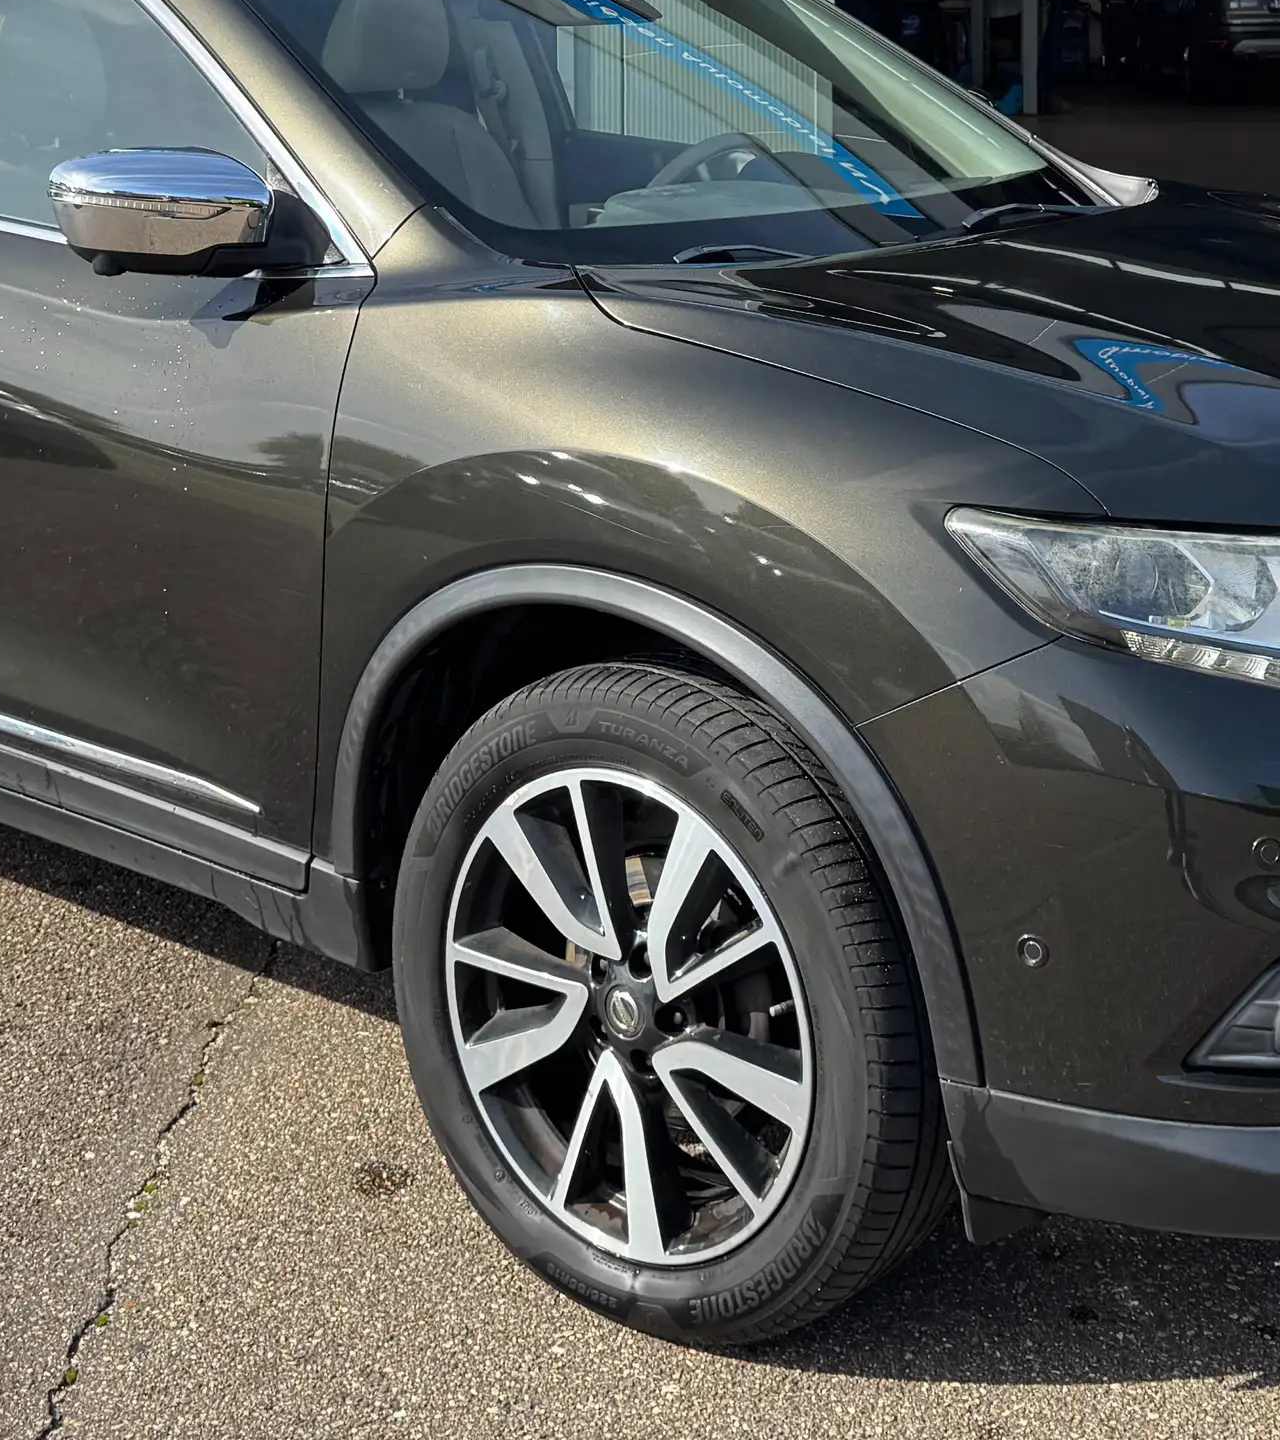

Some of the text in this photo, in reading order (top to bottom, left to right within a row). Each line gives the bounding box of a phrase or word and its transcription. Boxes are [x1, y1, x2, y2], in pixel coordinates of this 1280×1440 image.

[427, 719, 538, 835] BRIDGESTONE
[598, 720, 690, 771] TURANZA
[688, 1208, 827, 1324] BRIDGESTONE
